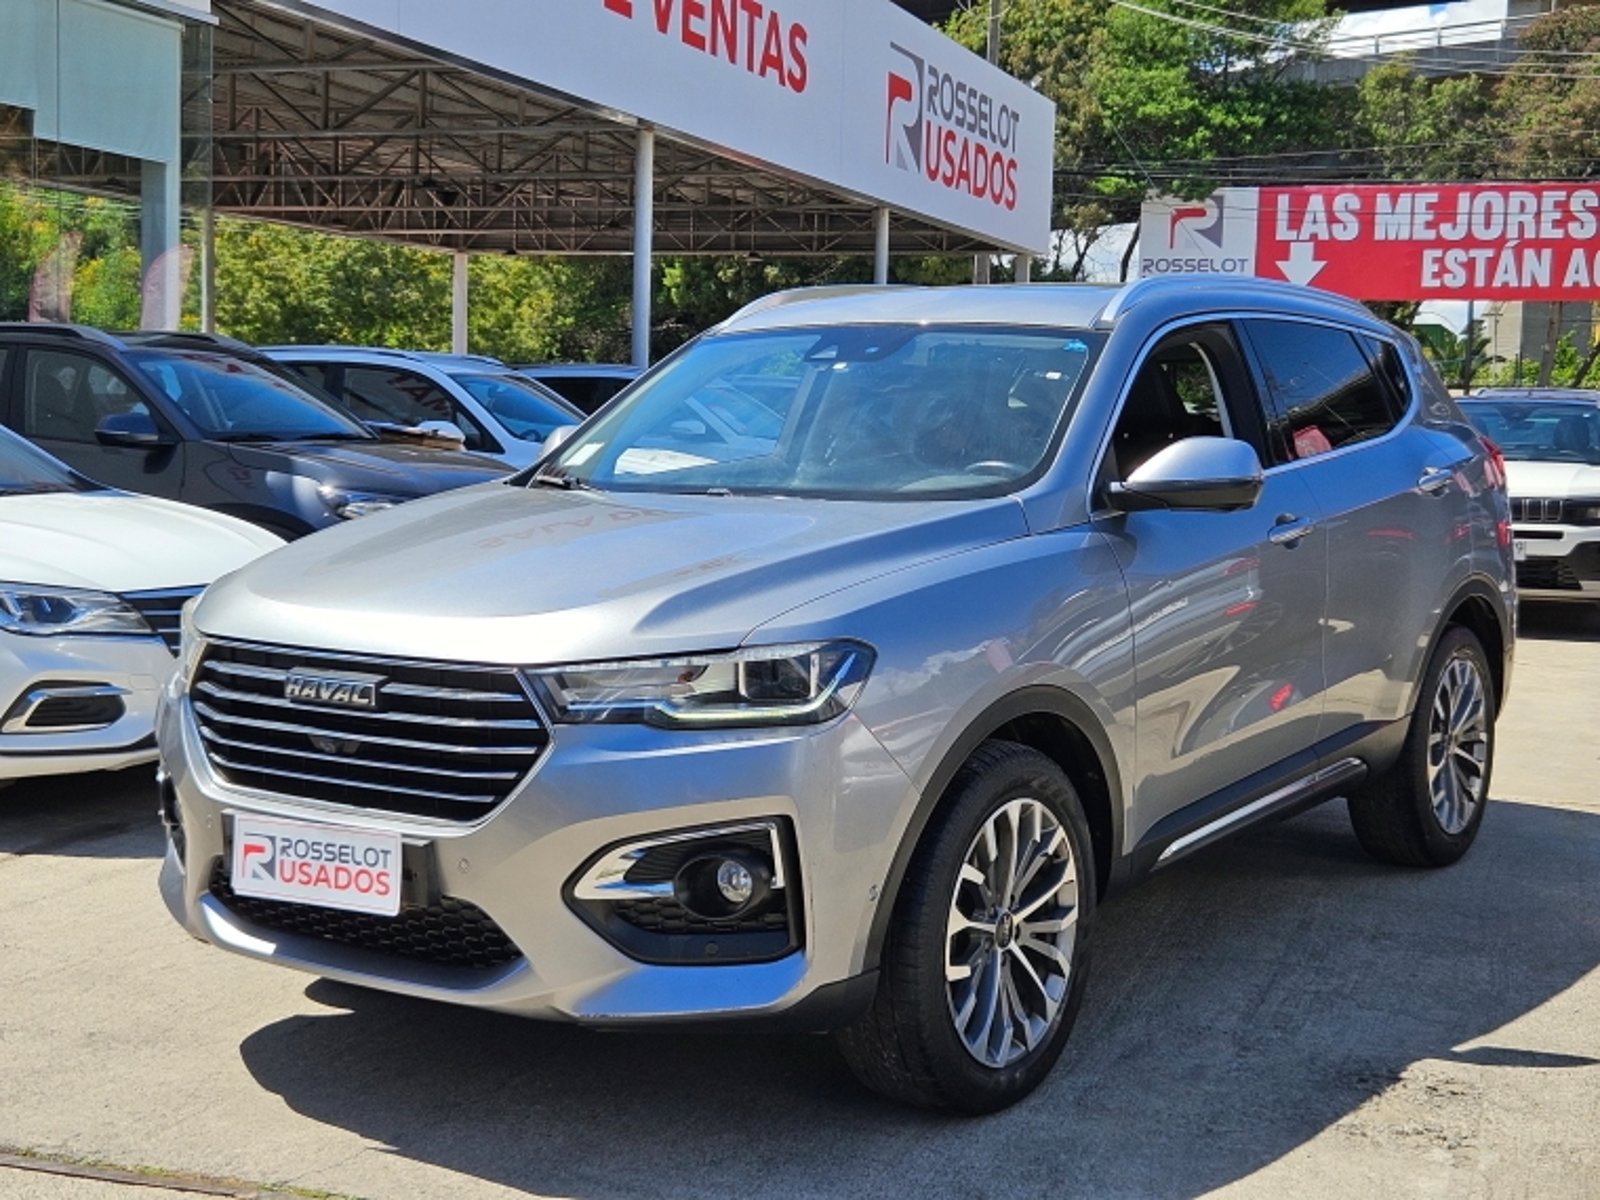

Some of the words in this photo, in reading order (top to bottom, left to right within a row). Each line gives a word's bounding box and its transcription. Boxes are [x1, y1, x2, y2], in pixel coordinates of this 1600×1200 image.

[927, 65, 1020, 153] ROSSELOT
[925, 119, 1018, 211] USADOS
[1275, 193, 1360, 241] LAS
[1374, 189, 1598, 241] MEJORES
[1142, 258, 1249, 273] ROSSELOT
[1420, 239, 1553, 288] ESTÁN
[1562, 248, 1600, 287] A
[284, 677, 371, 703] HAVAL
[279, 837, 392, 868] ROSSELOT
[279, 861, 391, 896] USADOS
